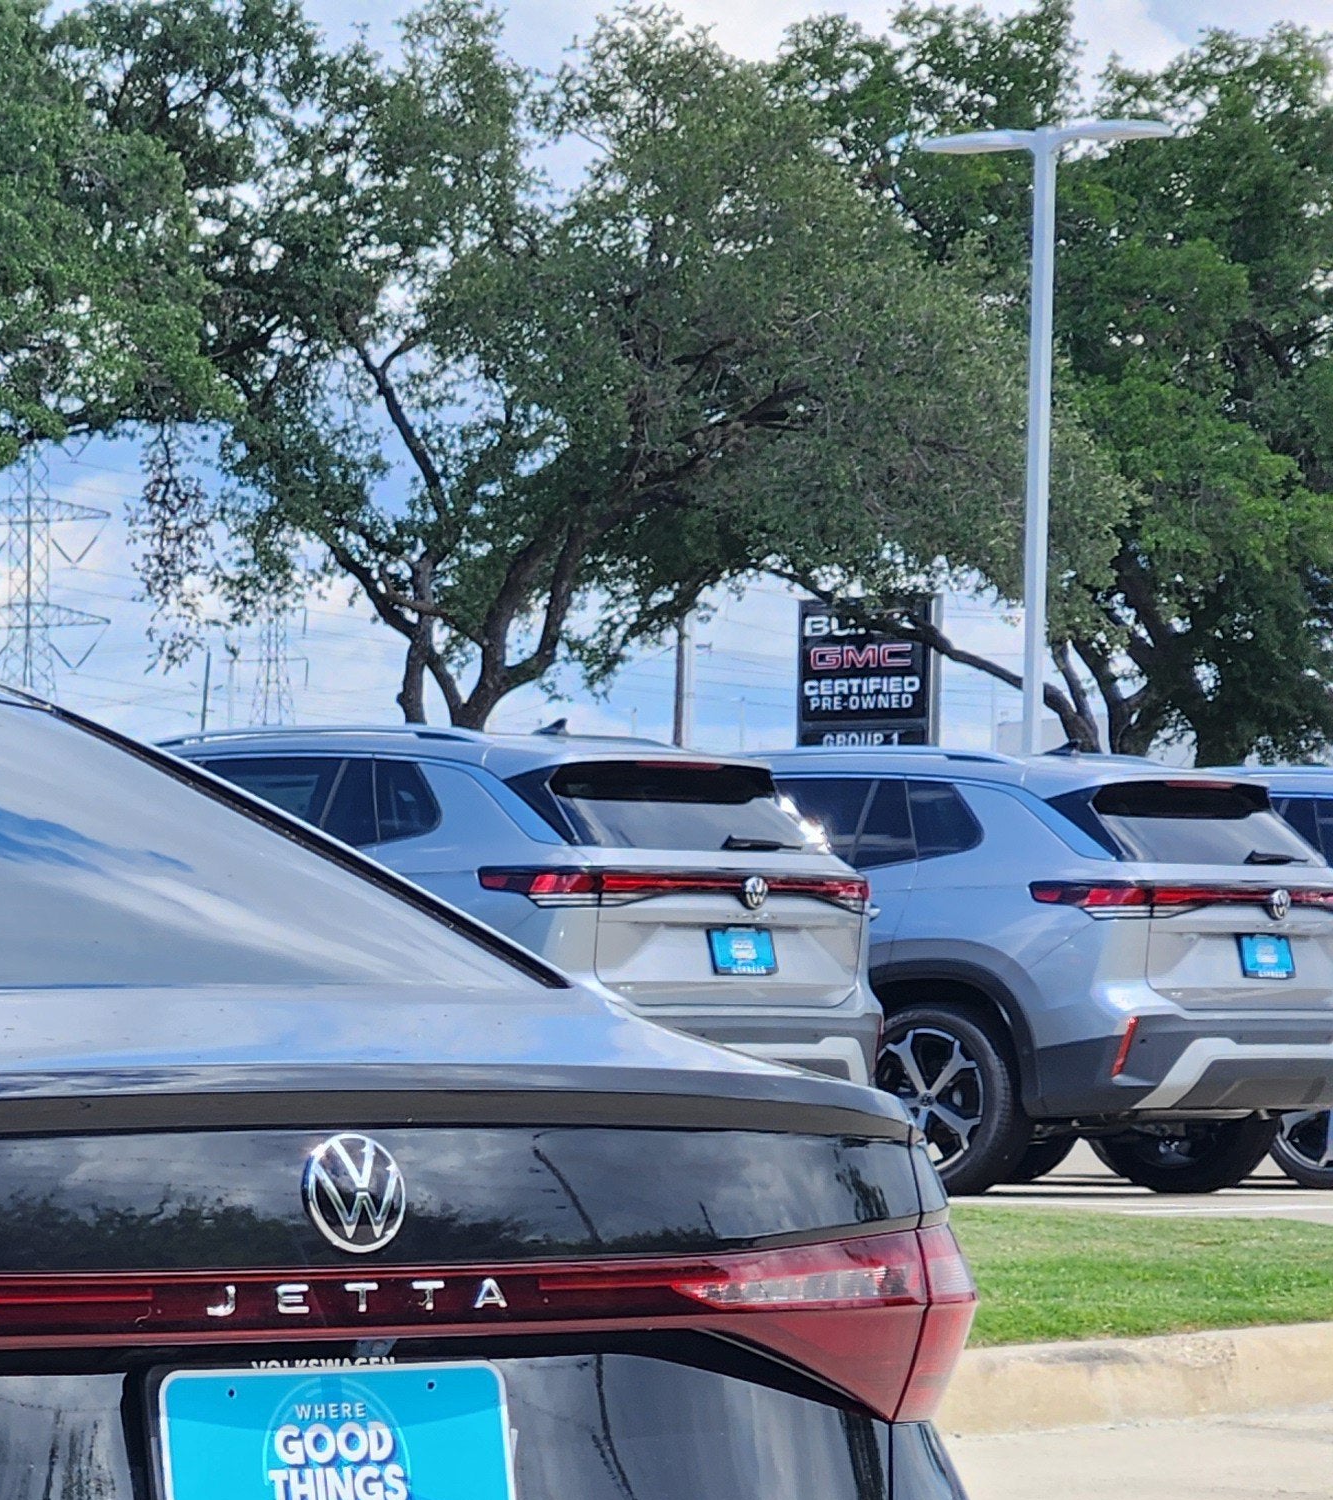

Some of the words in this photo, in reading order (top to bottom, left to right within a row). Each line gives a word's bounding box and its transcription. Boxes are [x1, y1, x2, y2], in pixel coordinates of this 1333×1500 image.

[810, 643, 912, 670] GMC
[803, 676, 921, 697] CERTIFIED
[809, 694, 913, 711] PRE-OWNED
[822, 731, 885, 747] GROUP
[205, 1277, 509, 1317] JETTA
[294, 1402, 367, 1420] WHERE
[273, 1421, 393, 1465] GOOD
